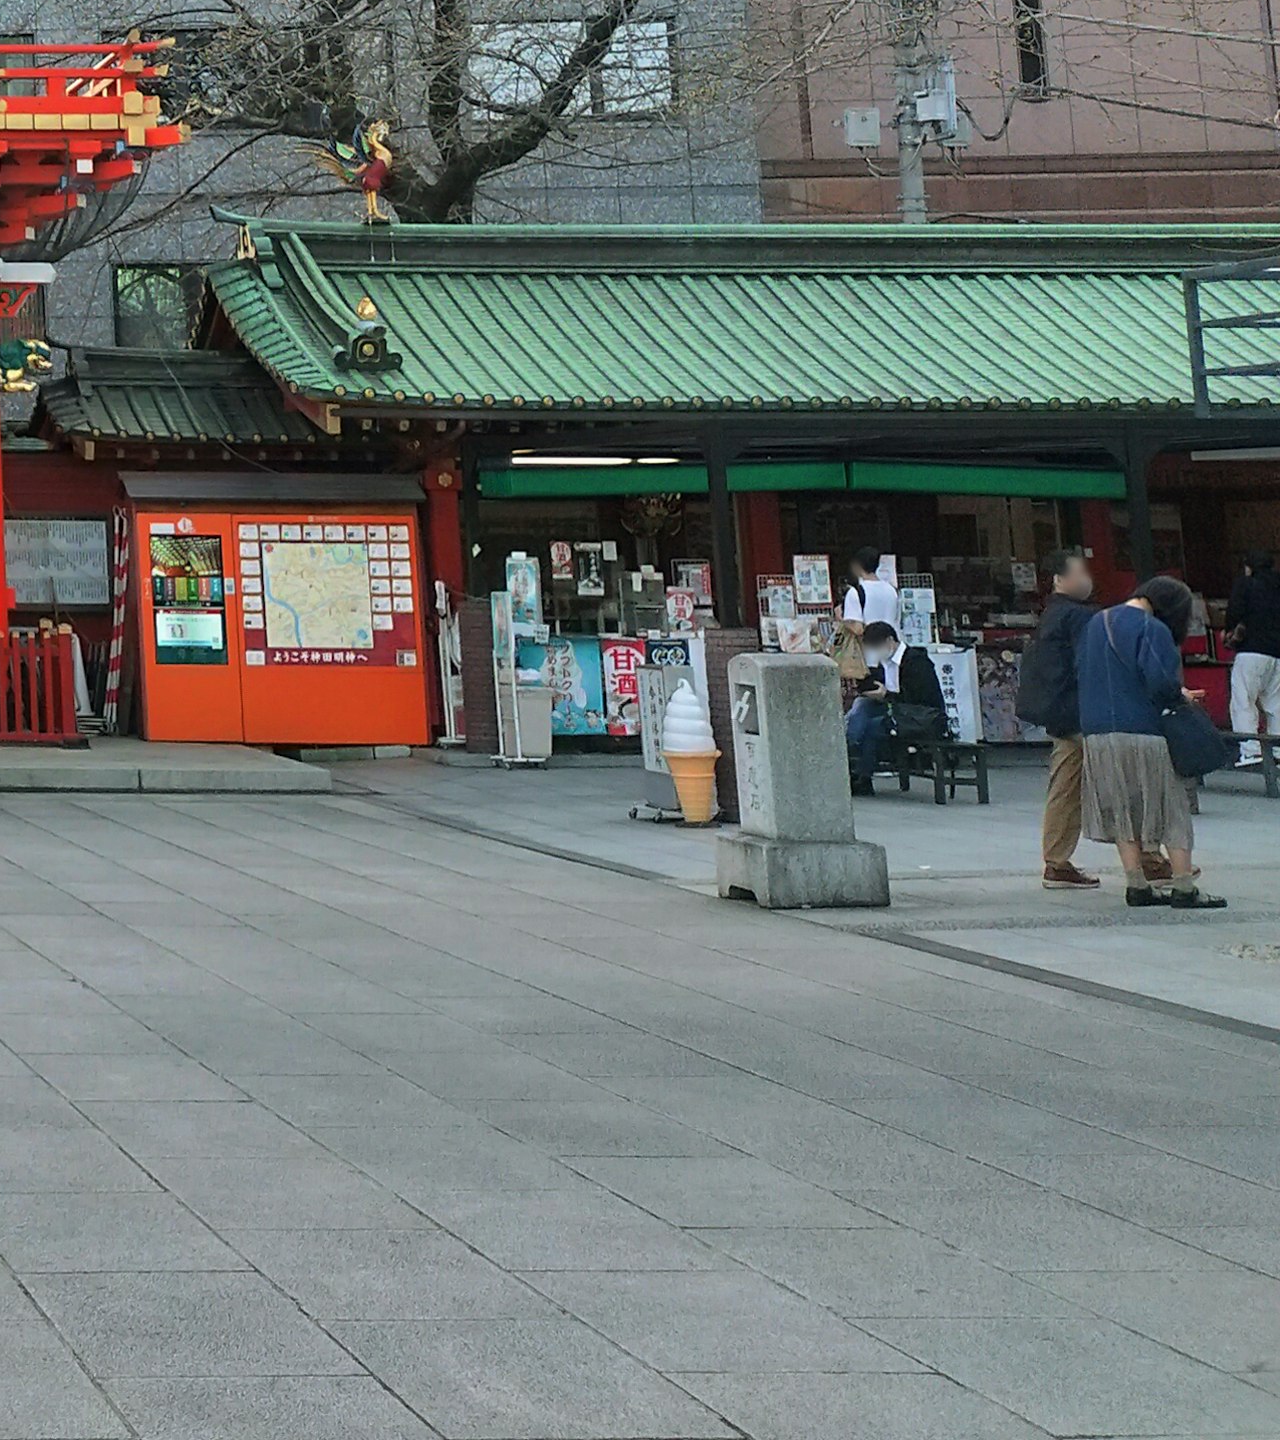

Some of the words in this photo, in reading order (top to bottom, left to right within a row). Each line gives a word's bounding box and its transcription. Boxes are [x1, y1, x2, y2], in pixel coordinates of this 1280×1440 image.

[674, 594, 687, 619] 甘酒
[273, 651, 368, 664] ようこそ神田明神へ
[610, 648, 637, 694] 甘酒
